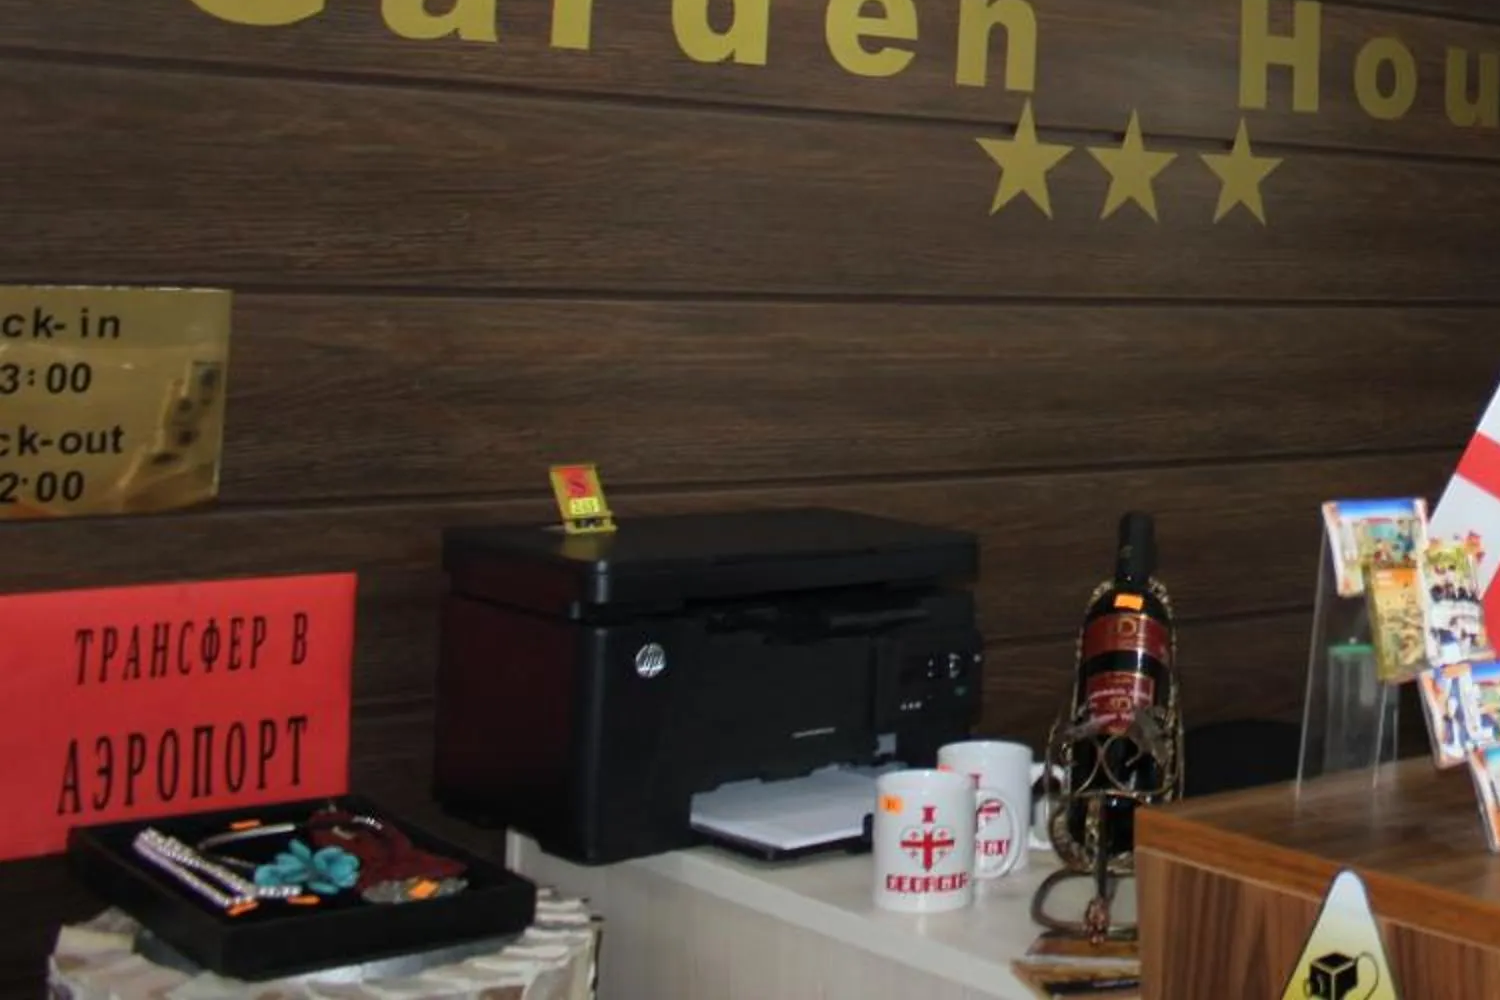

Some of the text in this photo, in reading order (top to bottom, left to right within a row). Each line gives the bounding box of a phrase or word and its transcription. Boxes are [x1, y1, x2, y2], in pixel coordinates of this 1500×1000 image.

[75, 612, 309, 686] ТРАНСФЕР В
[57, 714, 308, 817] АЭРОПОРТ
